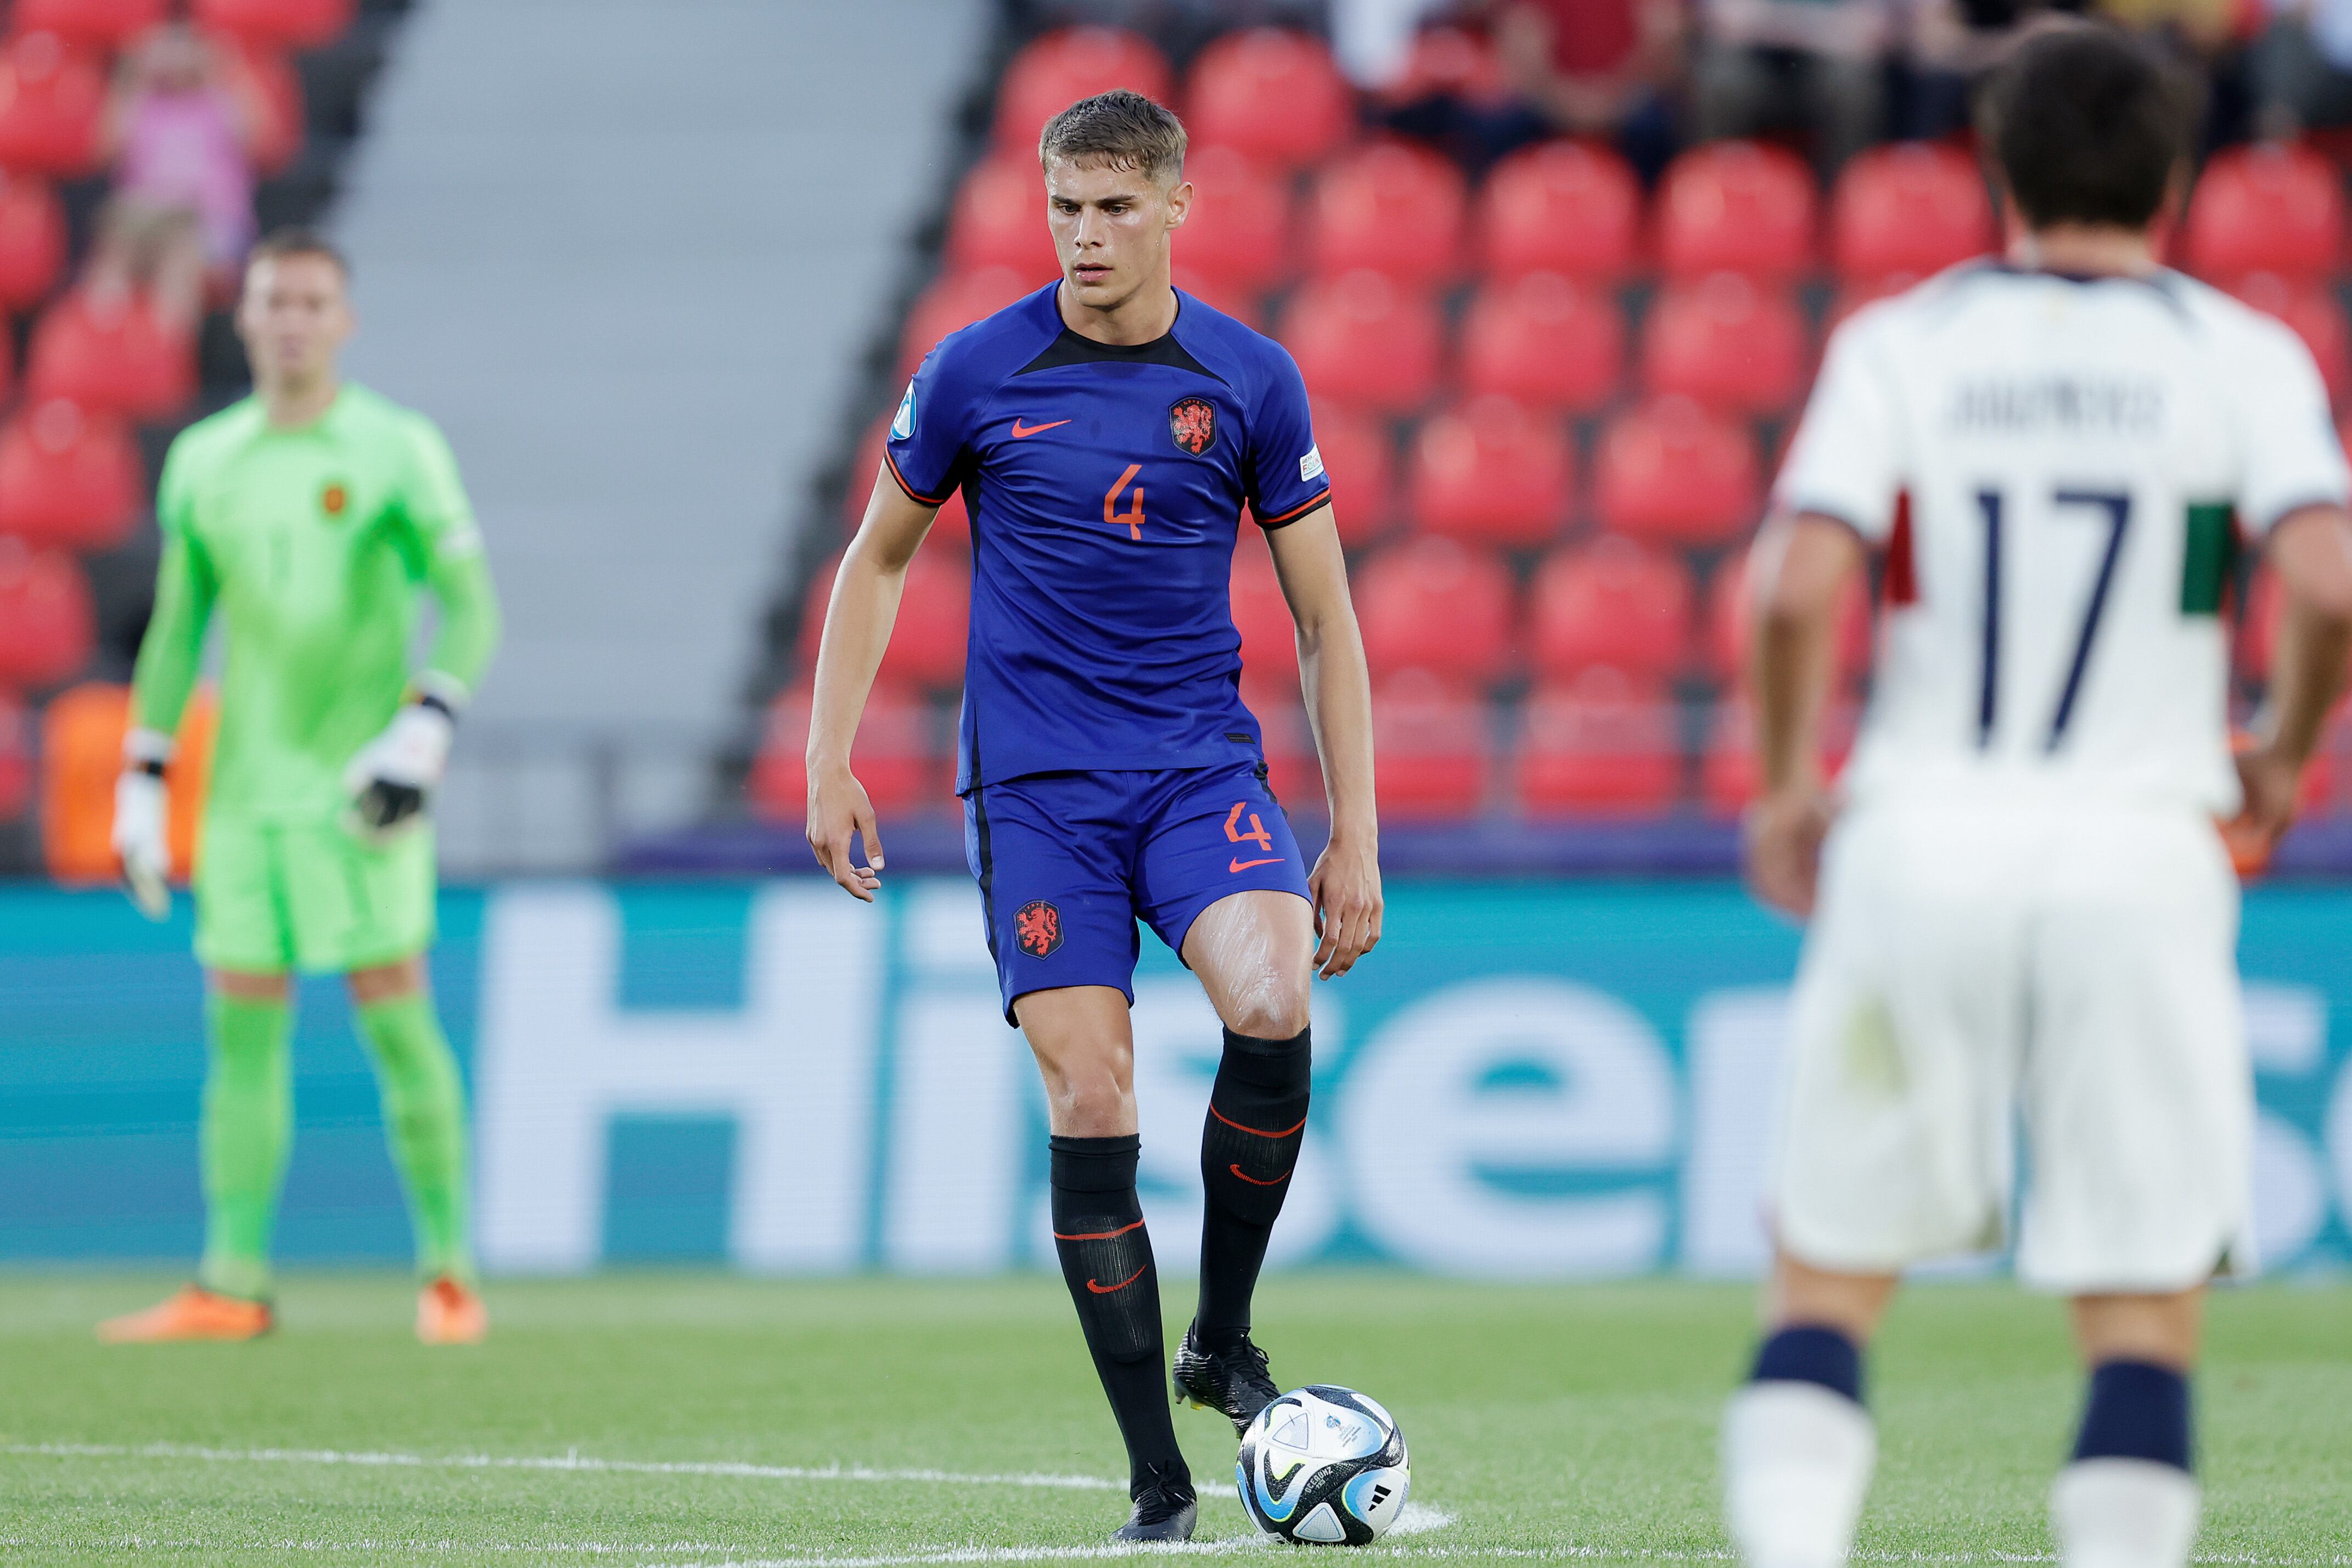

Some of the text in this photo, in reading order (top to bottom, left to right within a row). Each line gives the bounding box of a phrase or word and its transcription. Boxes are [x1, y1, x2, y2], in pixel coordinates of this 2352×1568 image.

[1103, 463, 1146, 541] 4
[1972, 486, 2132, 751] 17
[1223, 801, 1272, 851] 4
